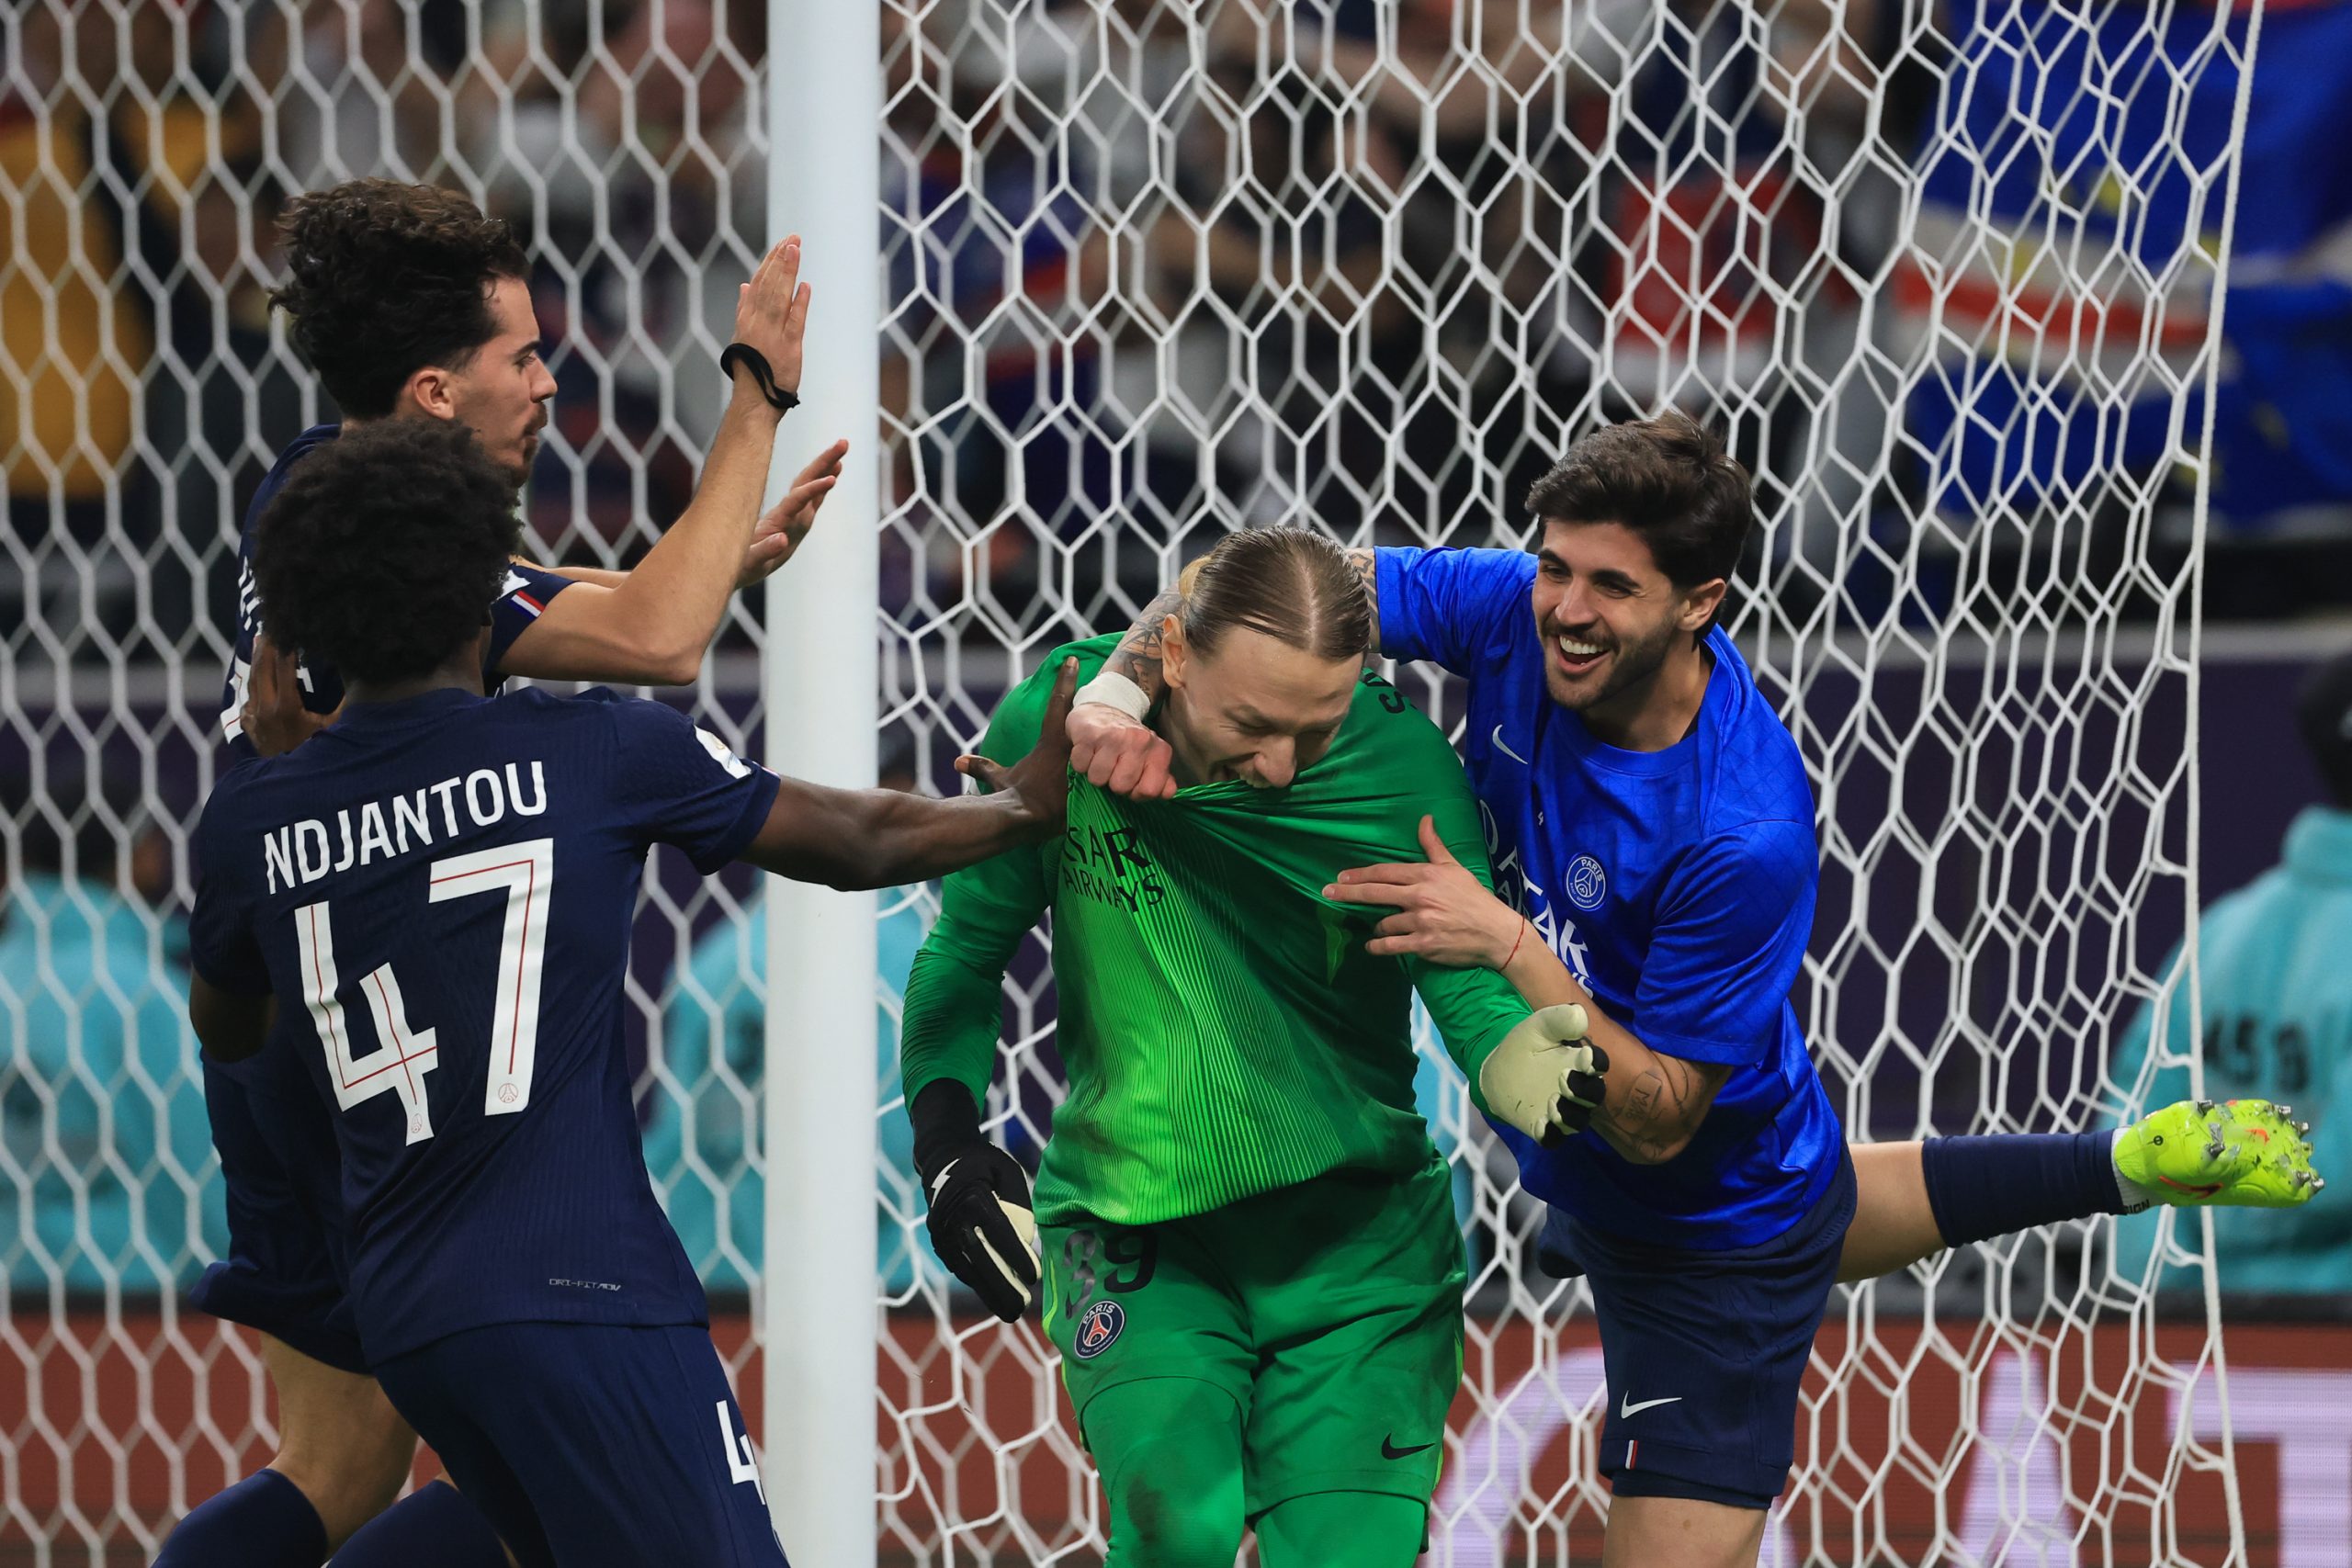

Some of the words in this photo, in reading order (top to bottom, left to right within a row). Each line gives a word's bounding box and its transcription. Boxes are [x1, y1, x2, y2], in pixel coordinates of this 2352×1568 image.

[263, 760, 548, 896] NDJANTOU
[1062, 865, 1164, 913] AIRWAYS
[1580, 858, 1604, 882] PARIS
[294, 837, 554, 1146] 47
[1064, 1228, 1159, 1320] 39
[1082, 1303, 1116, 1325] PARIS
